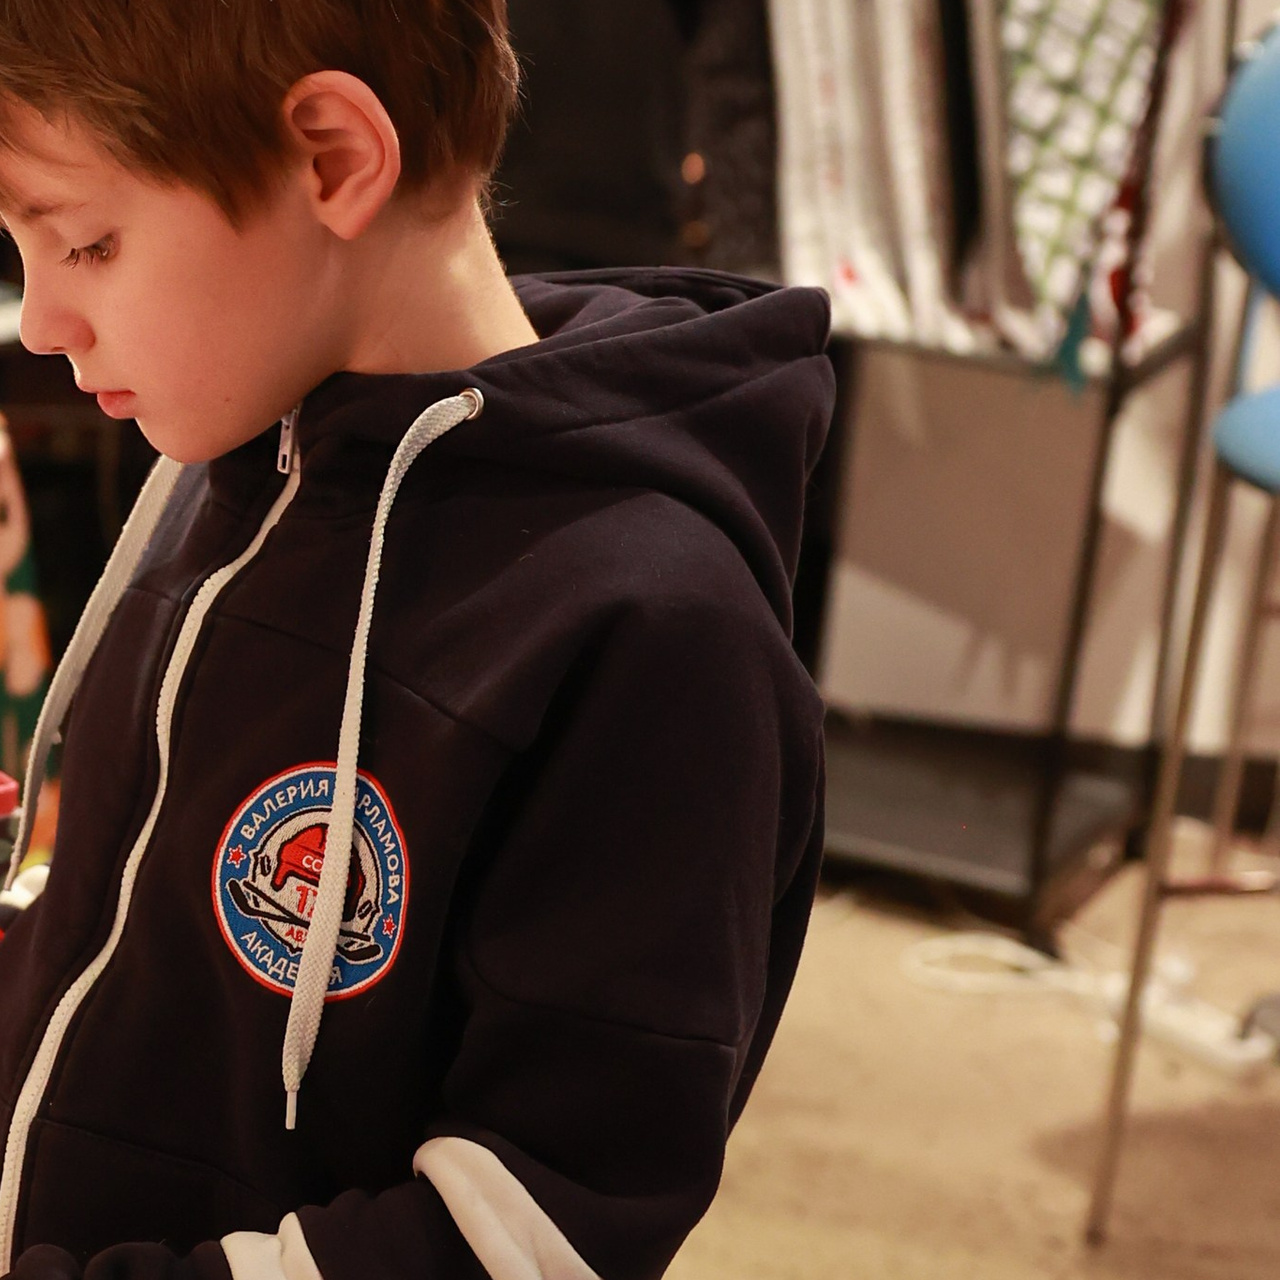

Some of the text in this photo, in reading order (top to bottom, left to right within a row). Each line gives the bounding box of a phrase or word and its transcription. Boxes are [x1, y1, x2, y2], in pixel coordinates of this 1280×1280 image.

[240, 778, 401, 905] ВАЛЕРИЯ РЛАМОВА
[240, 931, 343, 984] АКАДЕЯ
